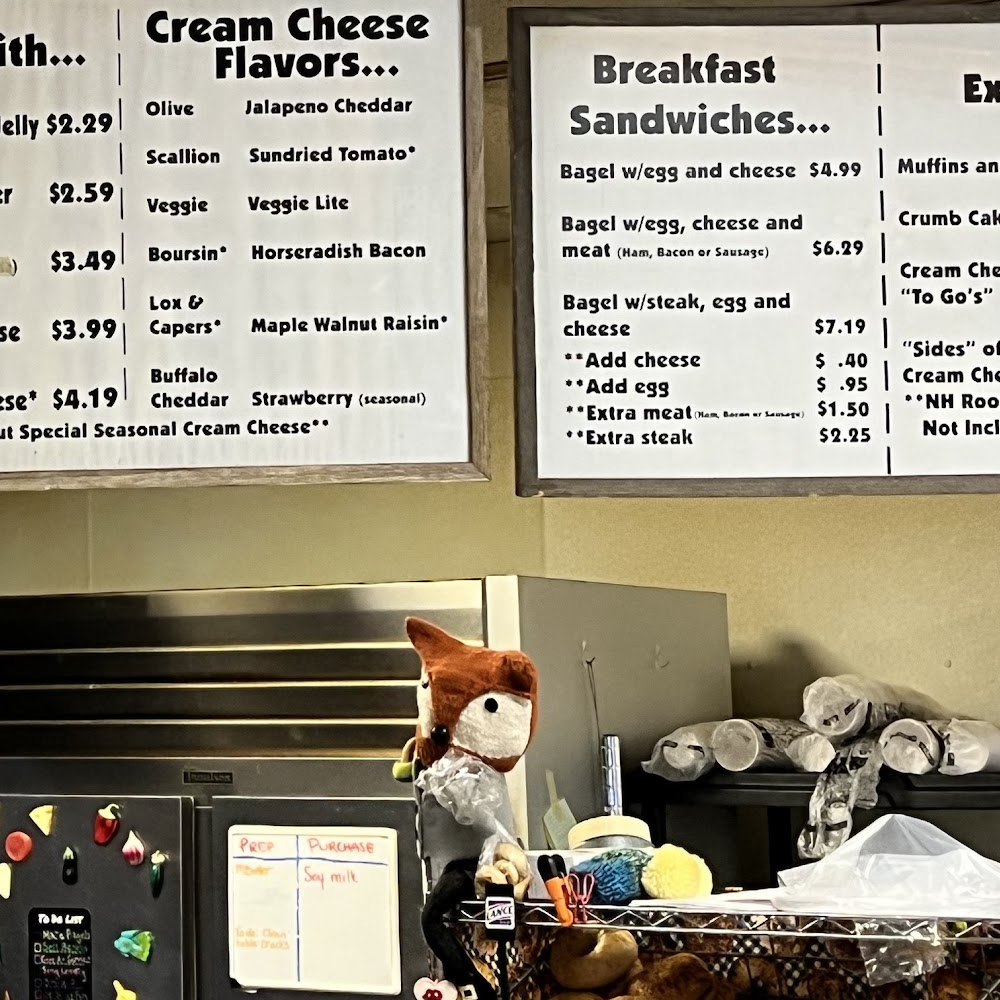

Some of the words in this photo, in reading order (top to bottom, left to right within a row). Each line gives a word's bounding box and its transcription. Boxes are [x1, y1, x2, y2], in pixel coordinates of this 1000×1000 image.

[146, 10, 273, 43] Cream
[287, 7, 430, 41] Cheese
[593, 53, 776, 84] Breakfast
[145, 100, 194, 116] Olive
[245, 99, 329, 117] Jalapeno
[334, 97, 413, 113] Cheddar
[47, 113, 113, 136] $2.29
[146, 148, 220, 165] Scallion
[249, 146, 333, 163] Sundried
[560, 163, 615, 183] Bagel
[621, 162, 678, 183] w/egg
[685, 162, 722, 179] and
[729, 162, 796, 178] cheese
[809, 162, 861, 178] $4.99
[898, 157, 969, 174] Muffins
[49, 182, 114, 205] $2.59
[146, 196, 208, 216] Veggie
[247, 195, 309, 215] Veggie
[316, 194, 349, 210] Lite
[561, 215, 616, 236] Bagel
[622, 215, 685, 235] w/egg,
[692, 214, 759, 231] cheese
[766, 214, 803, 230] and
[898, 209, 962, 226] Crumb
[252, 243, 363, 260] Horseradish
[369, 243, 426, 258] Bacon
[562, 243, 611, 258] meat
[617, 247, 653, 260] (Ham,
[657, 247, 694, 257] Bacon
[698, 249, 711, 257] or
[715, 246, 769, 259] Sausage)
[812, 240, 864, 257] $6.29
[51, 249, 116, 273] $3.49
[900, 262, 961, 279] Cream
[149, 295, 182, 311] Lox
[188, 294, 204, 310] &
[563, 293, 618, 314] Bagel
[624, 293, 705, 313] w/steak,
[712, 296, 747, 313] egg
[753, 292, 791, 309] and
[52, 318, 117, 342] $3.99
[251, 317, 308, 336] Maple
[313, 316, 377, 332] Walnut
[563, 320, 630, 337] cheese
[815, 318, 866, 335] $7.19
[634, 351, 701, 368] cheese
[151, 367, 218, 383] Buffalo
[902, 367, 964, 383] Cream
[53, 387, 118, 411] $4.19
[252, 389, 353, 409] Strawberry
[358, 392, 426, 407] (seasonal)
[634, 381, 669, 398] egg
[151, 391, 229, 409] Cheddar
[643, 405, 692, 420] meat
[817, 400, 869, 417] $1.50
[19, 422, 87, 443] Special
[94, 421, 176, 438] Seasonal
[183, 421, 240, 436] Cream
[641, 428, 693, 445] steak
[819, 427, 871, 443] $2.25
[923, 419, 958, 436] Not
[240, 838, 275, 853] PREP
[308, 838, 374, 854] PURCHASE
[304, 866, 325, 890] Soy
[331, 869, 359, 883] milk
